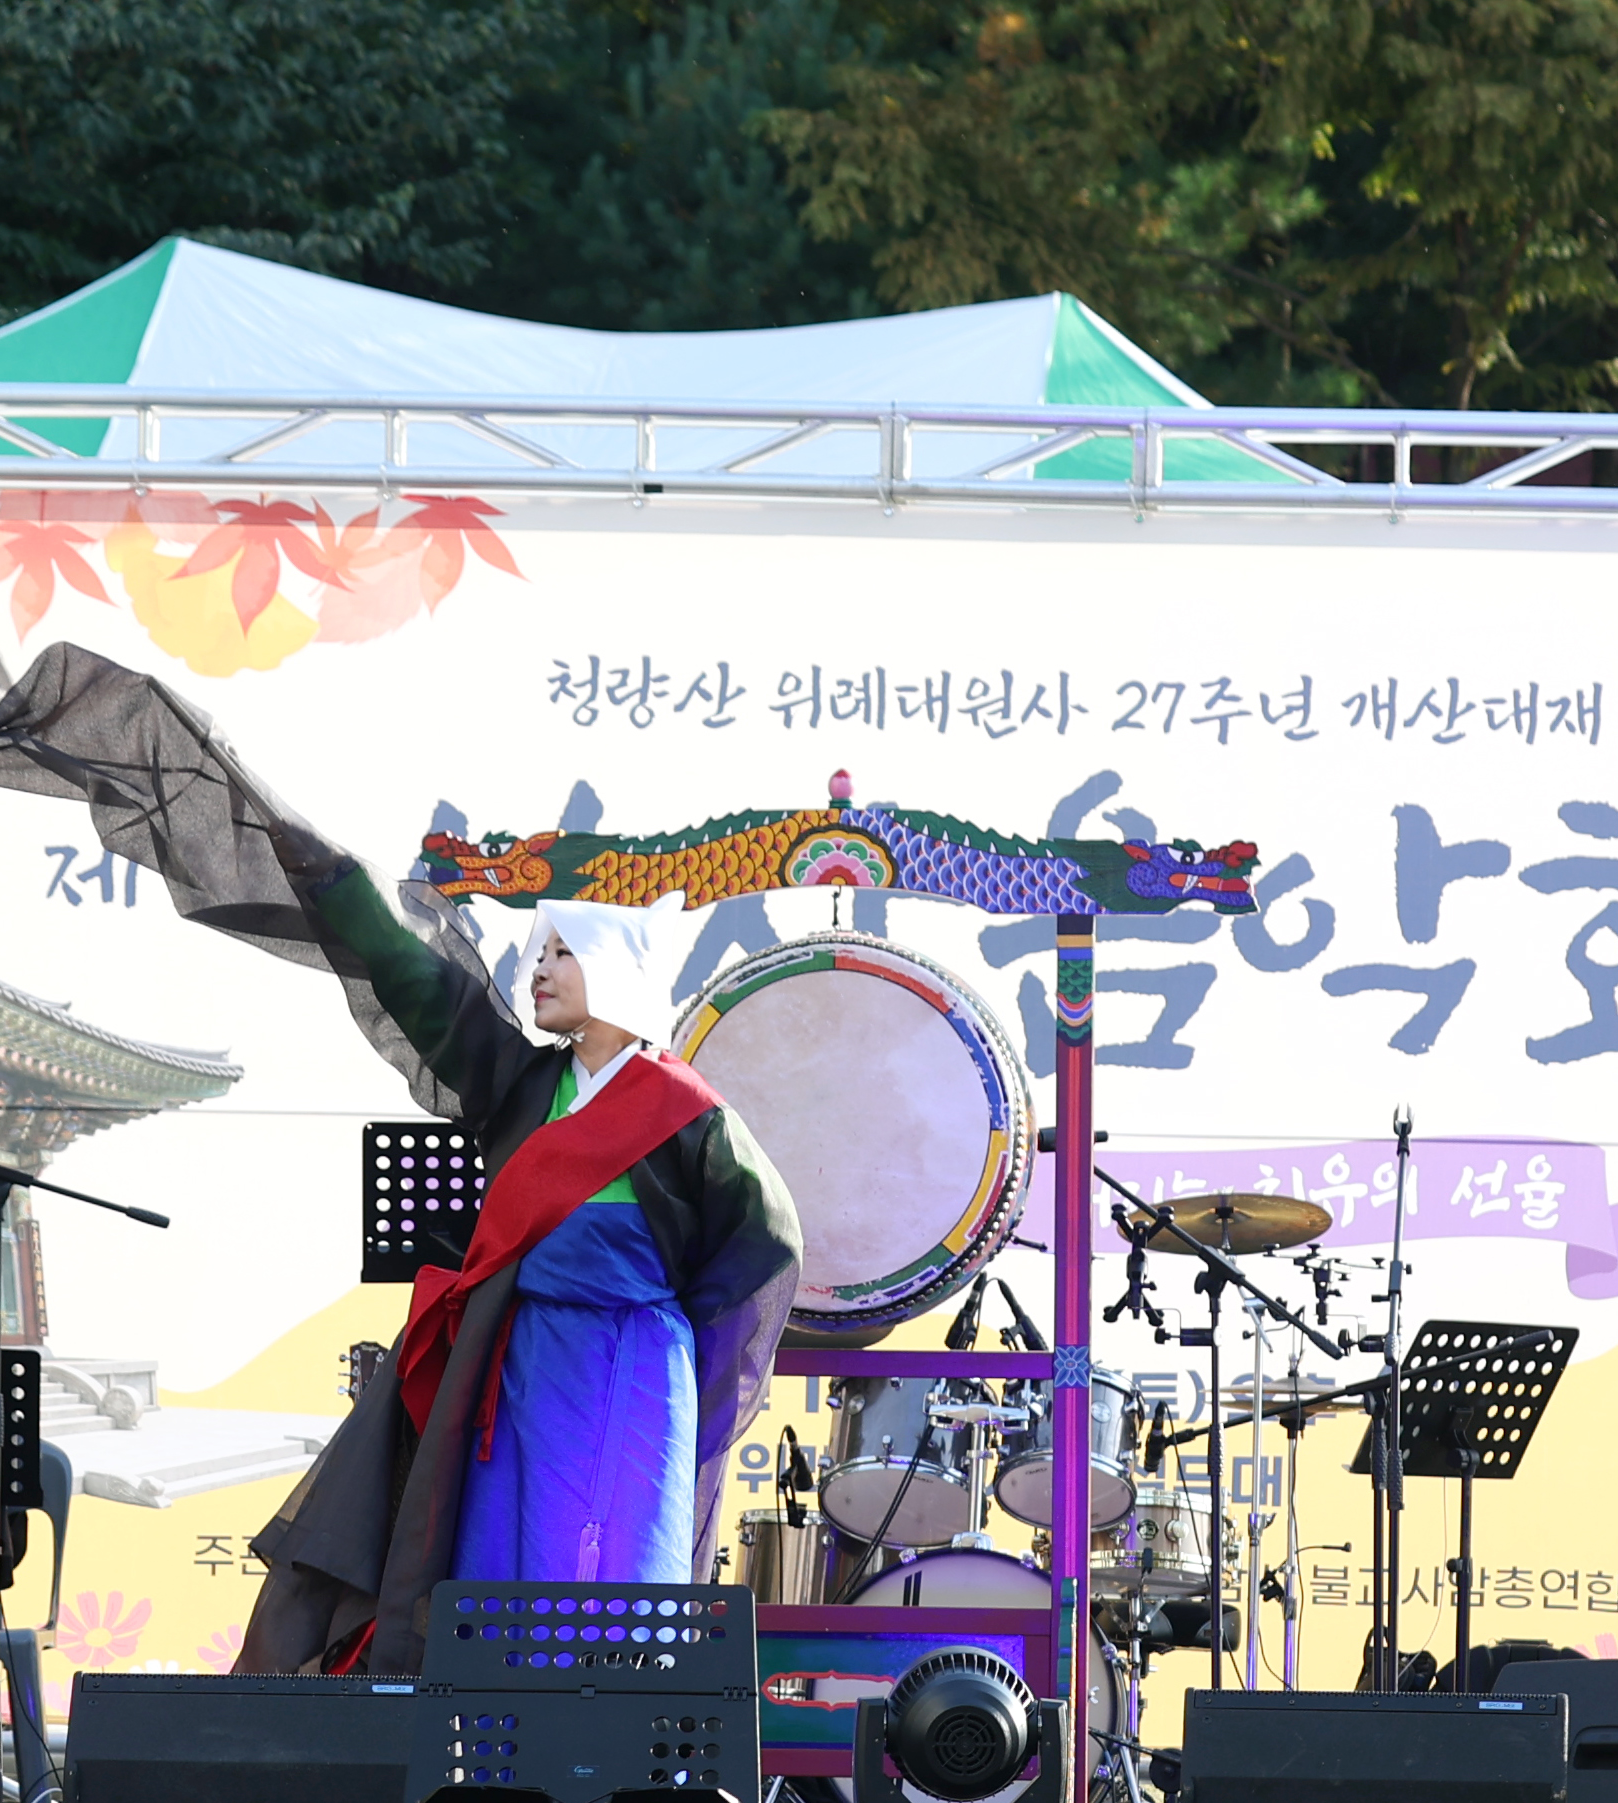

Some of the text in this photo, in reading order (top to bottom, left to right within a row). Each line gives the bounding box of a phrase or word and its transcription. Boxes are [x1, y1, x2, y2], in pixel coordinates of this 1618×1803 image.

[547, 655, 1603, 746] 청량산 위례대원사 27주년 개산대재
[1253, 1152, 1418, 1229] 치유의
[1450, 1153, 1567, 1231] 선율
